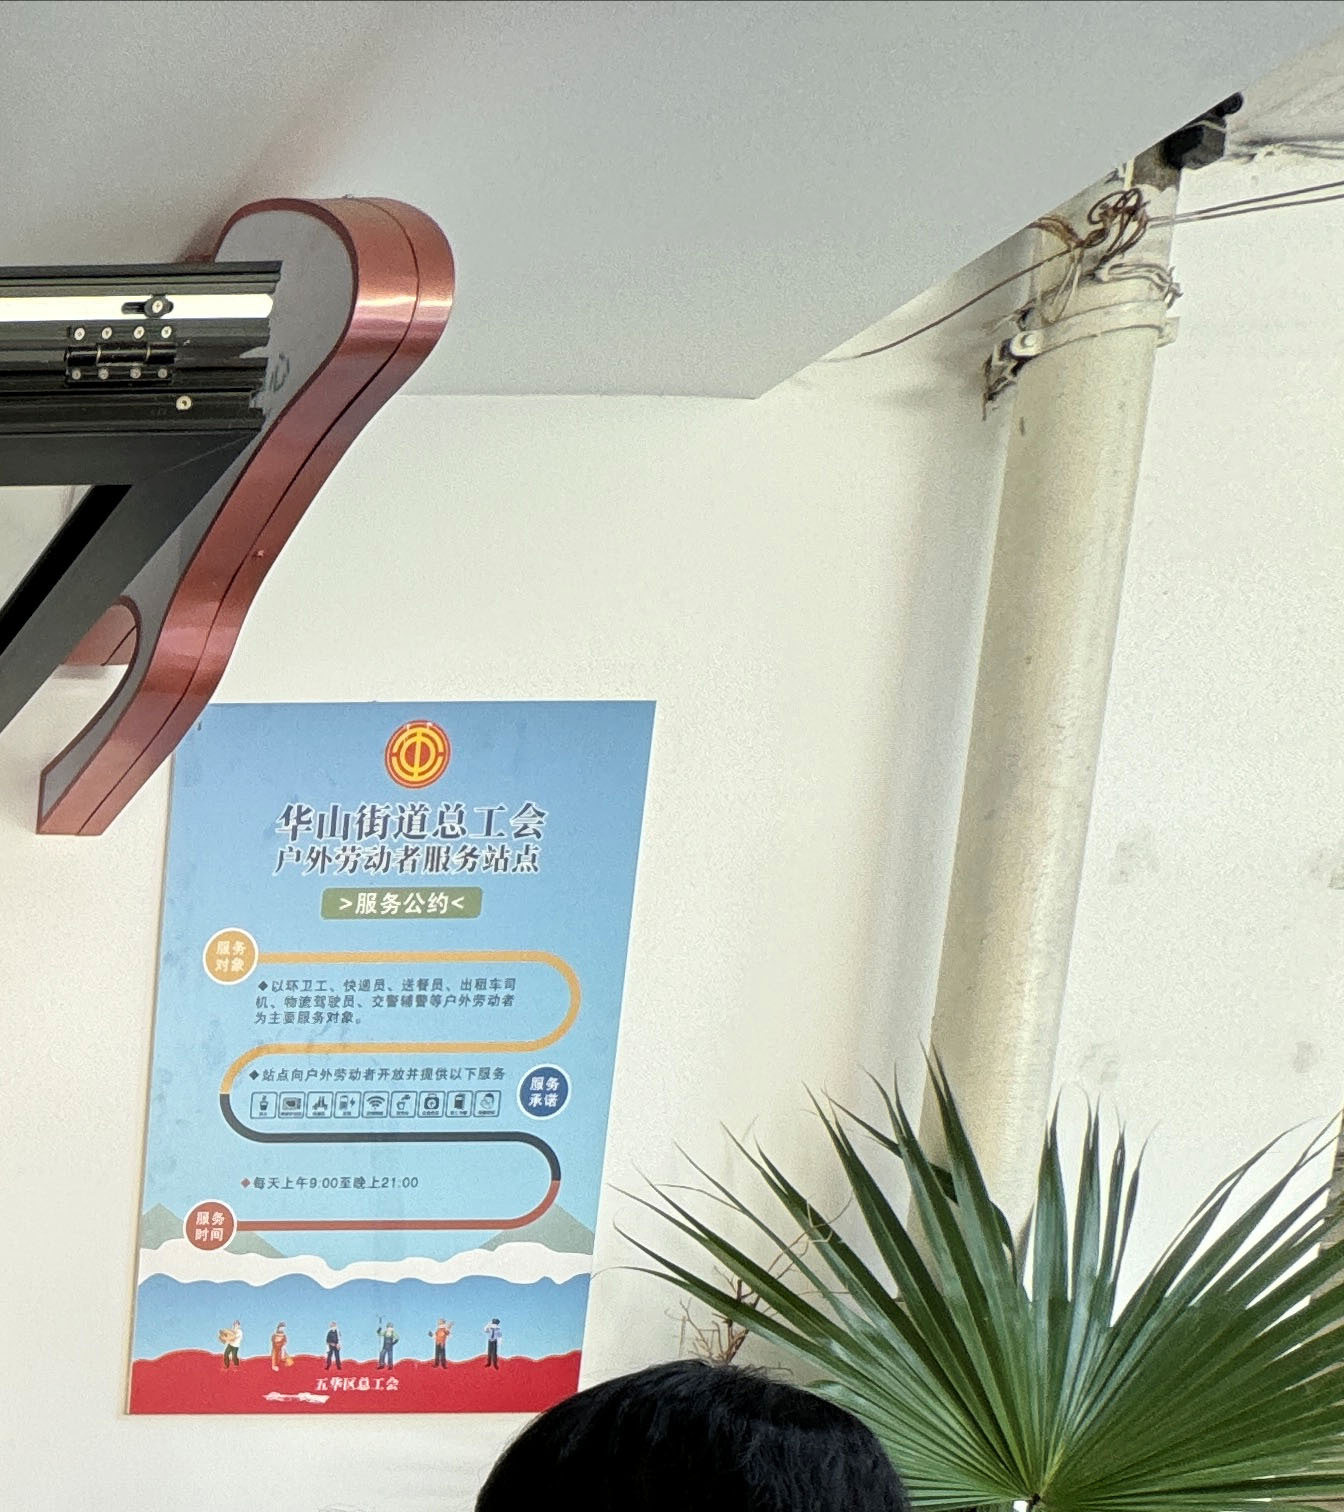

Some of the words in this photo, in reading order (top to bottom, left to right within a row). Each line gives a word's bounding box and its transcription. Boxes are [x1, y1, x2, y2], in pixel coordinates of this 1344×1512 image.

[275, 801, 549, 843] 华山街道总工会
[273, 845, 541, 876] 户外劳动者服务站点
[527, 1092, 559, 1108] 承诺
[315, 1376, 400, 1392] 五华区总工会
